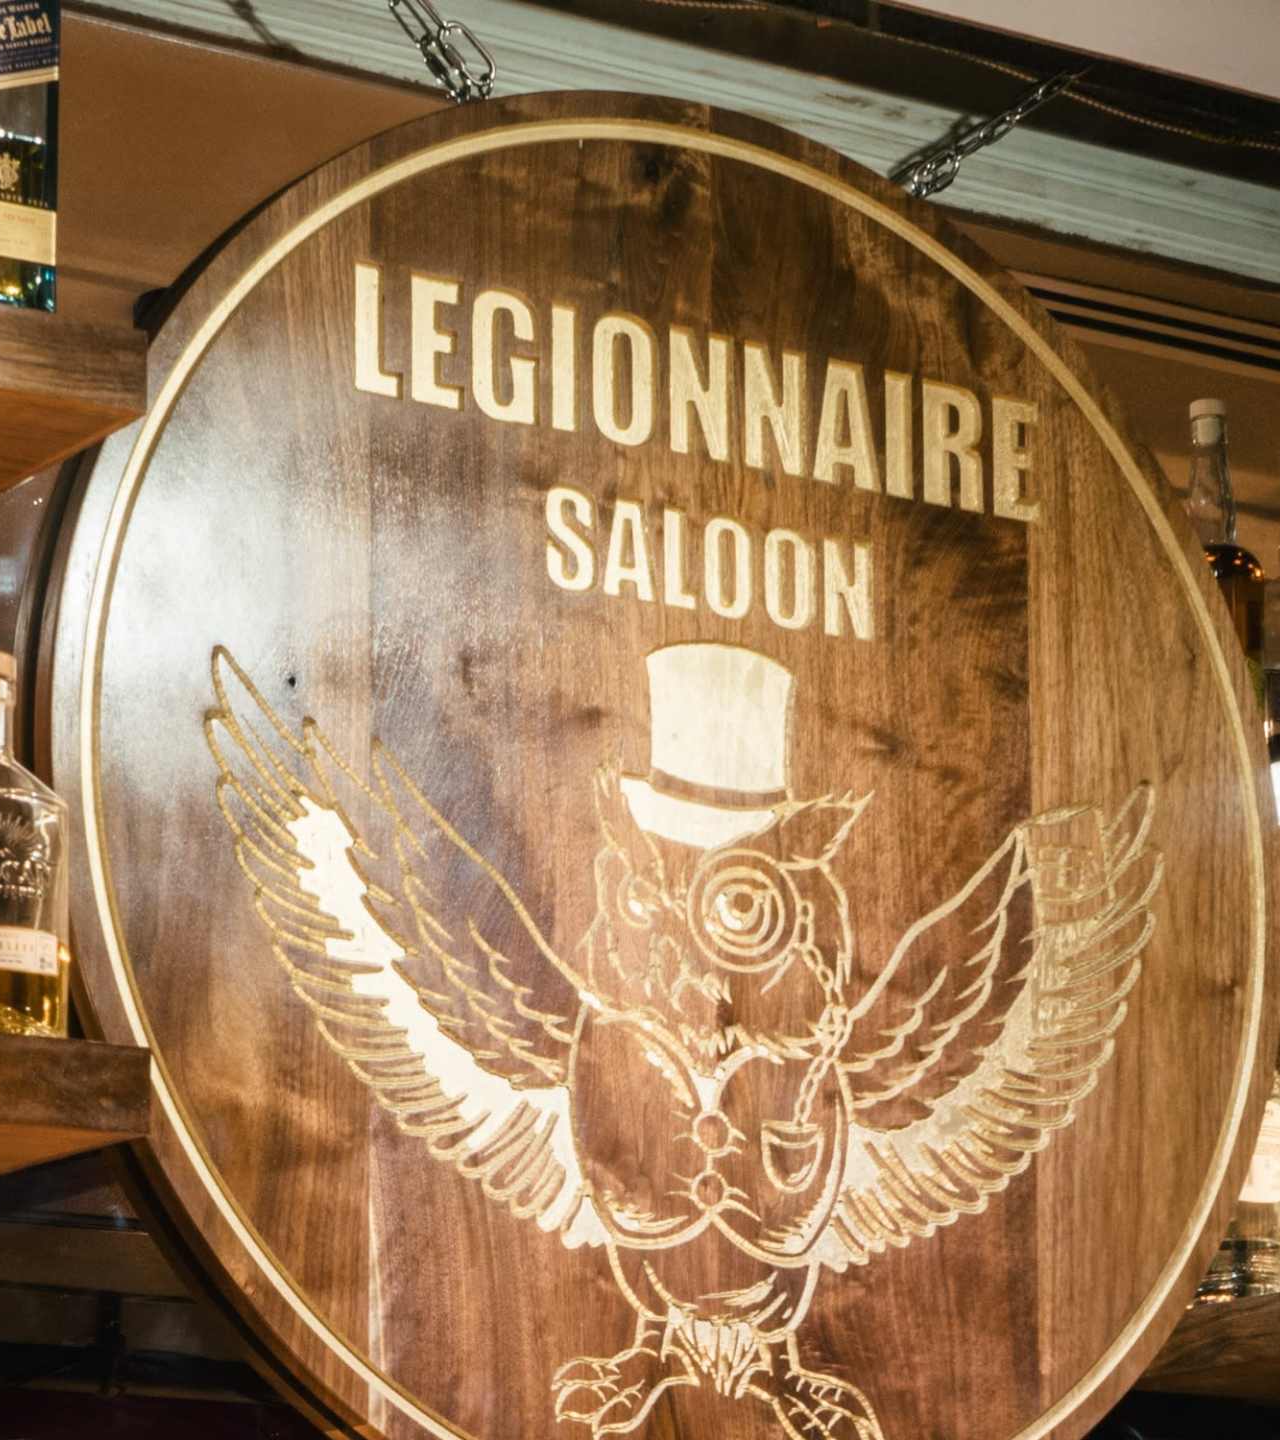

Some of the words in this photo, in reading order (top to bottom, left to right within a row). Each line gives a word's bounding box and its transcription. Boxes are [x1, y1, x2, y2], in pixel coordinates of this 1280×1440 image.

[9, 13, 52, 41] Label
[353, 261, 1040, 523] LEGIONNAIRE
[546, 487, 874, 640] SALOON
